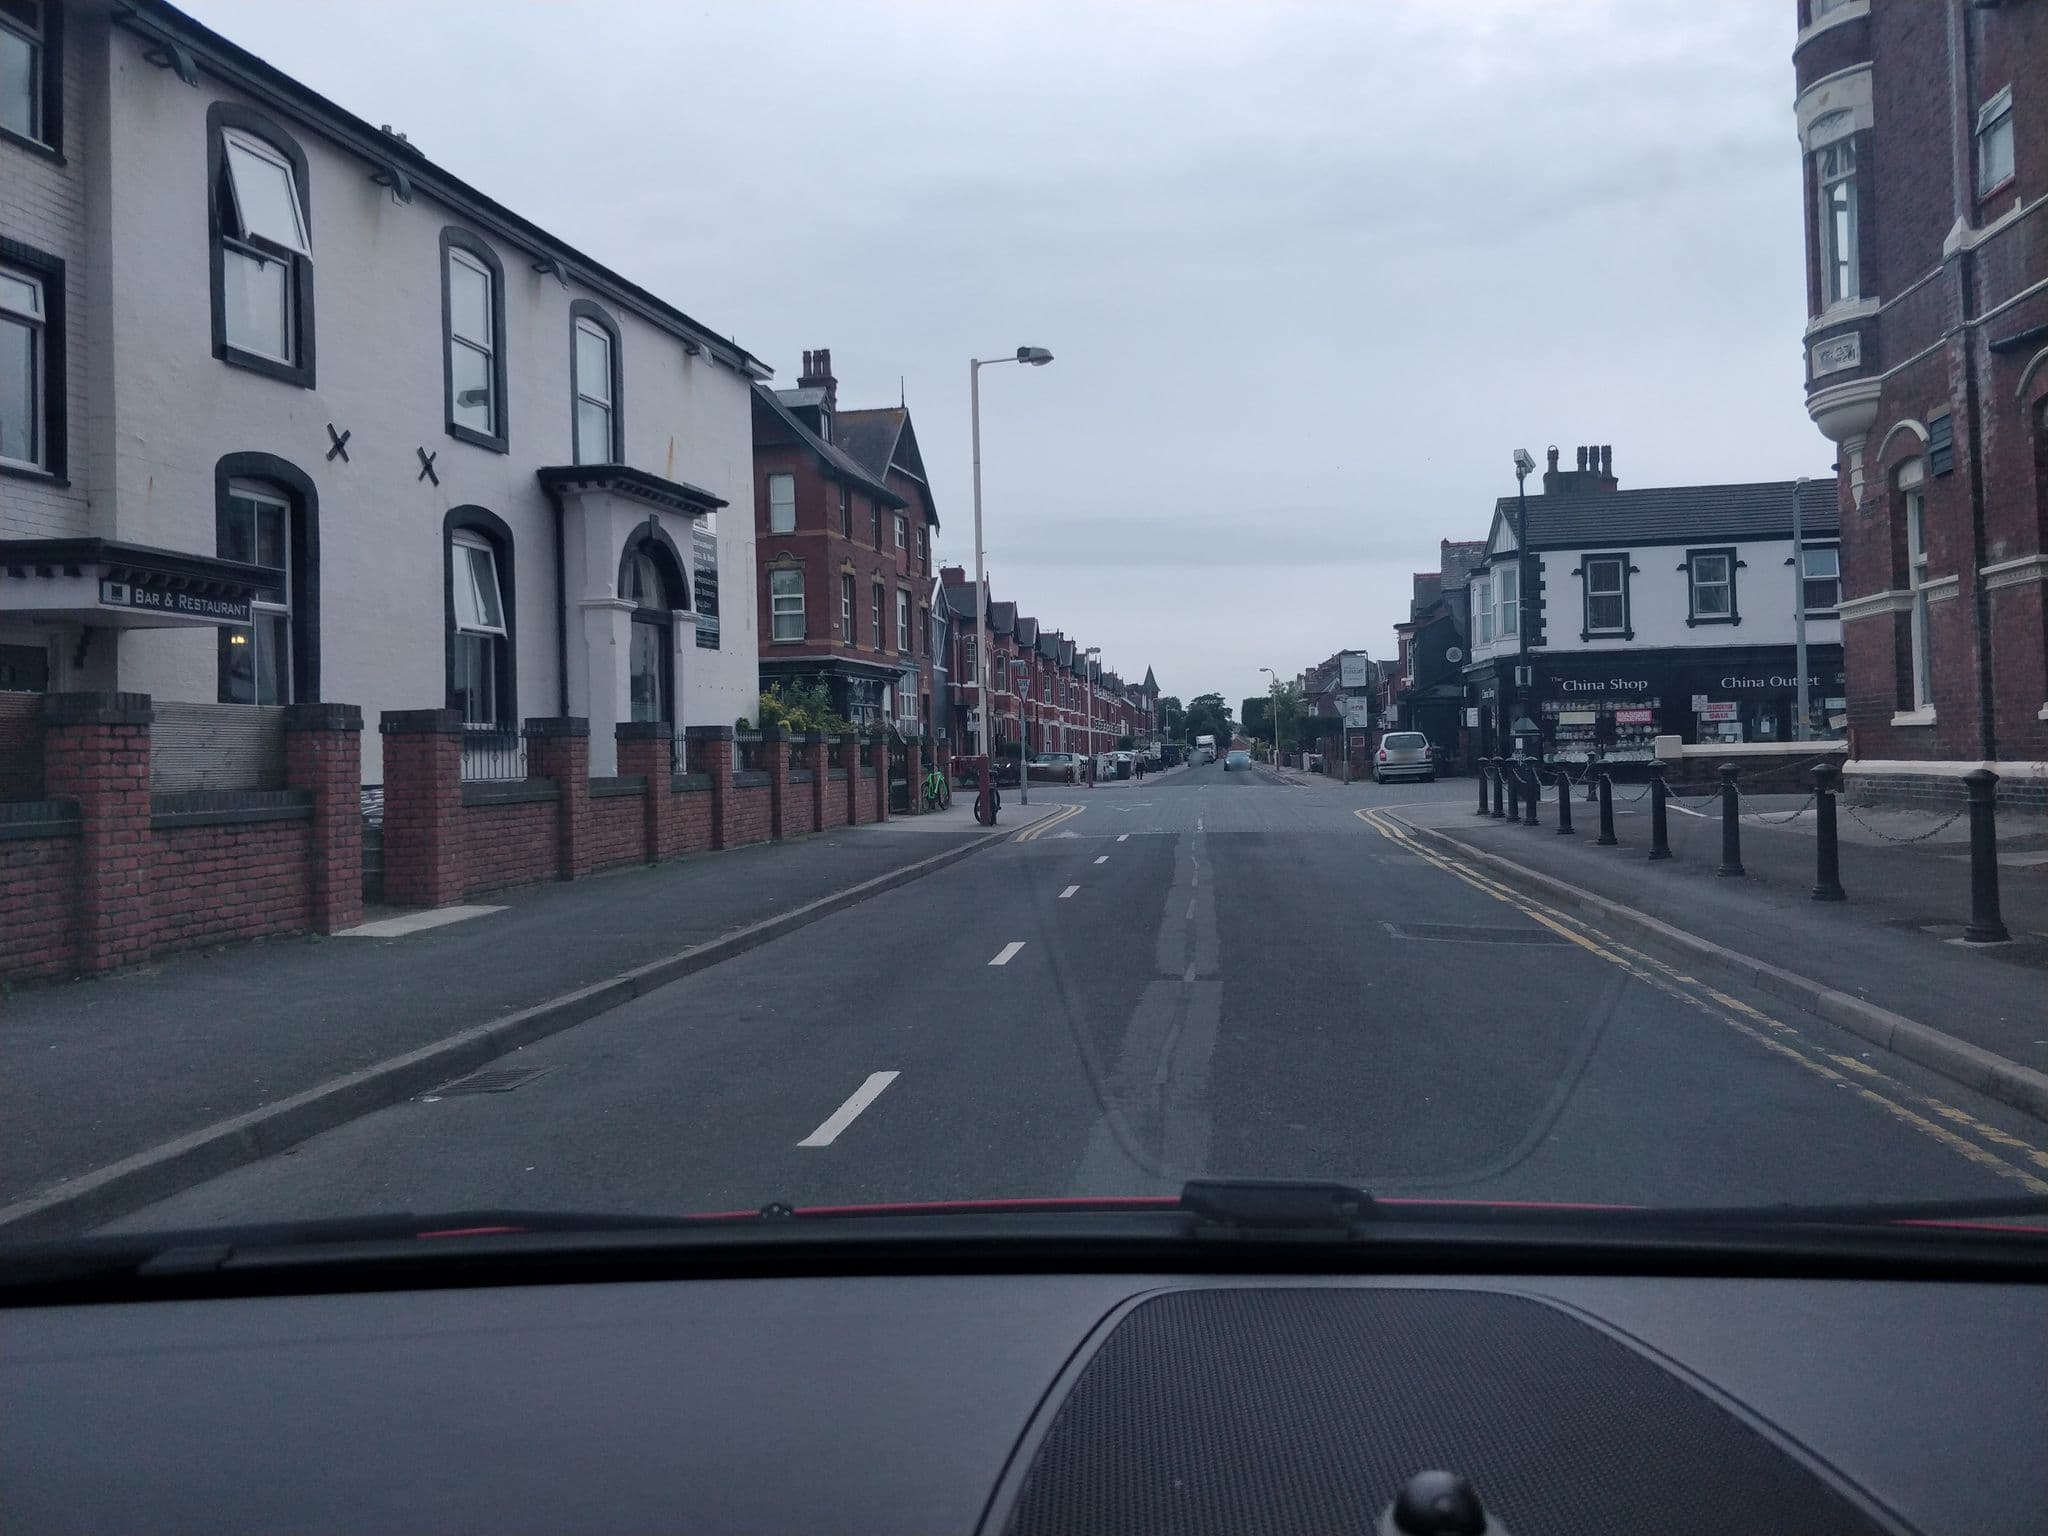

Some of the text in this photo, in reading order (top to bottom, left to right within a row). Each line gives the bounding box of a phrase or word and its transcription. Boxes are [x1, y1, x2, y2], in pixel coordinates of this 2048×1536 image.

[135, 588, 247, 617] BAR & RESTAURANT
[1562, 679, 1605, 692] China
[1610, 678, 1648, 692] Shop
[1721, 676, 1765, 689] China
[1769, 675, 1821, 688] Outet
